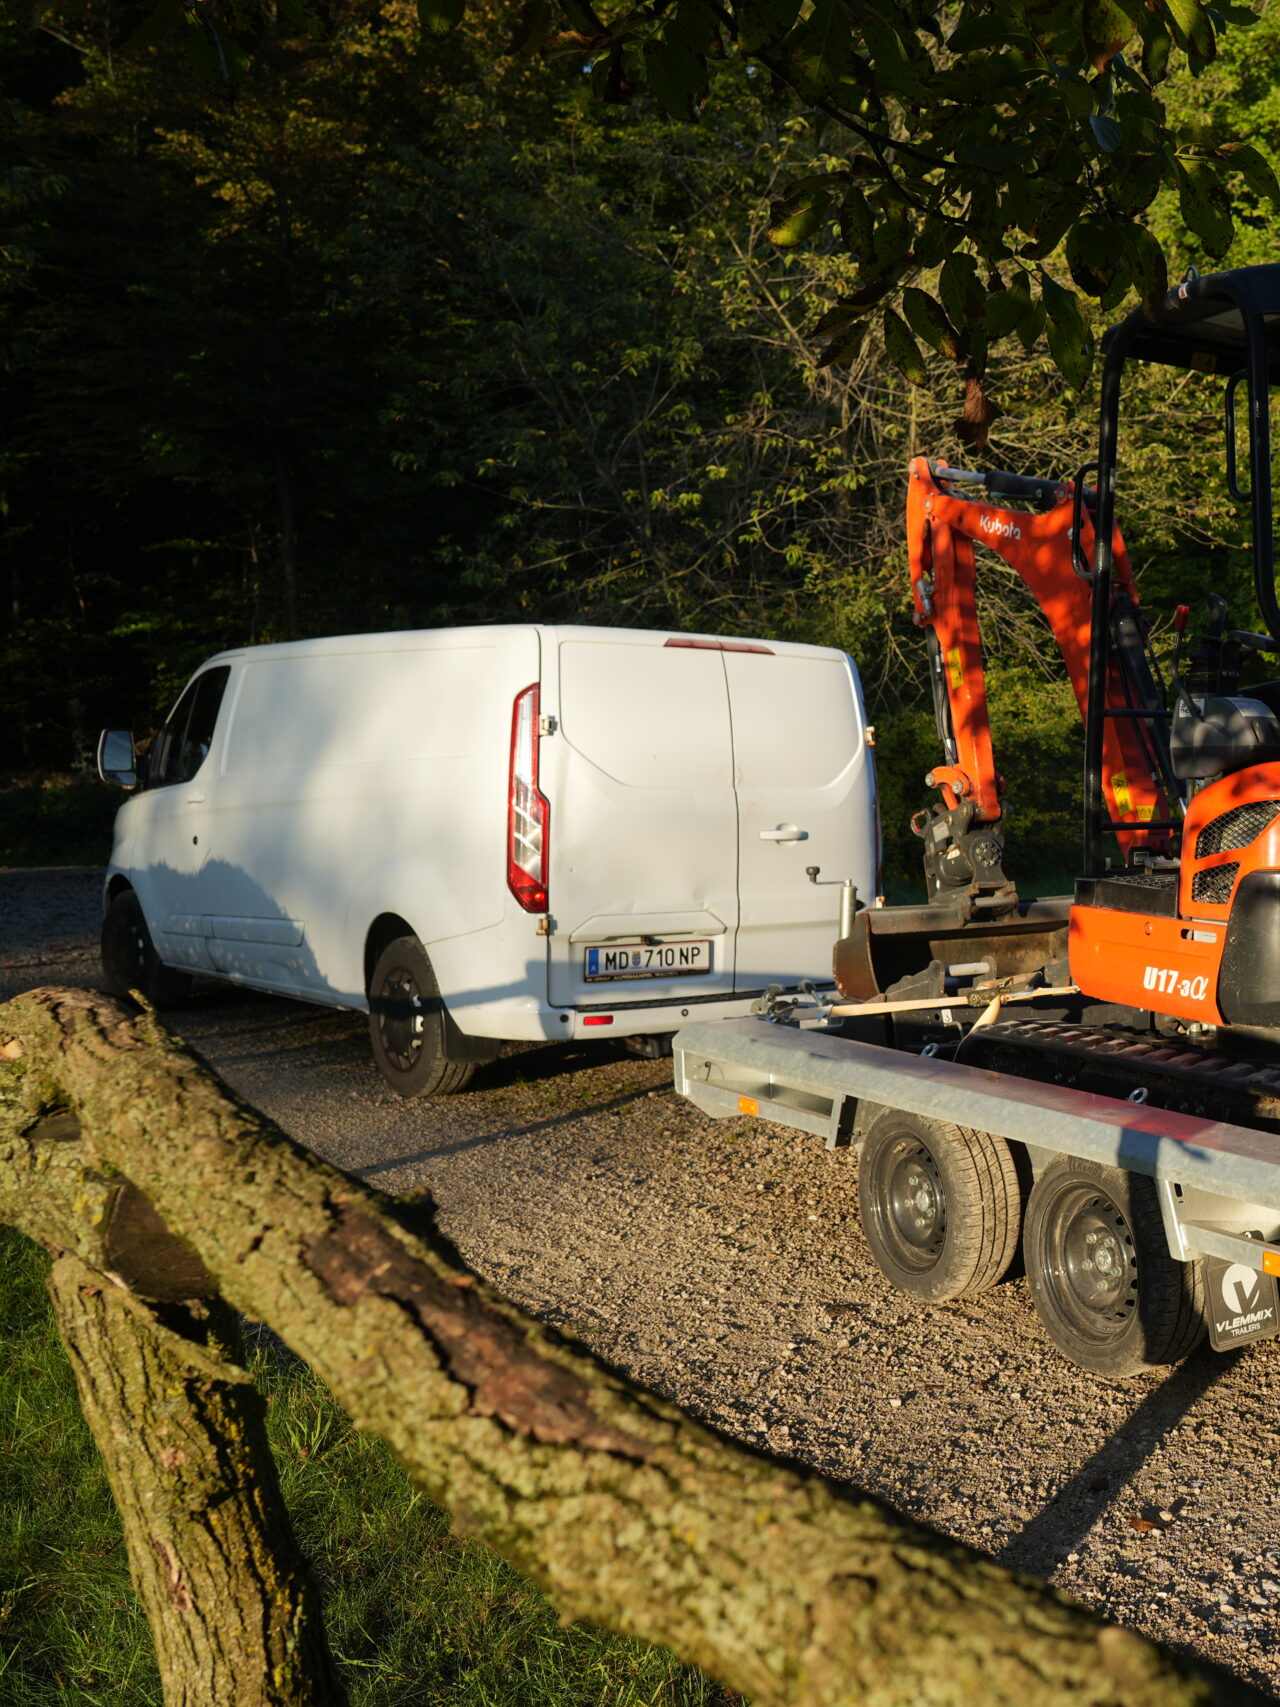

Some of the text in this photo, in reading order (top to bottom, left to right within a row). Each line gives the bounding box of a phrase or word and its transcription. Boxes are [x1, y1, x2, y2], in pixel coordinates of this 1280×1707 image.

[980, 514, 1021, 540] Kubota
[605, 951, 630, 971] MD
[1216, 1307, 1274, 1333] VLEMMIX
[1231, 1322, 1261, 1337] TRAILERS
